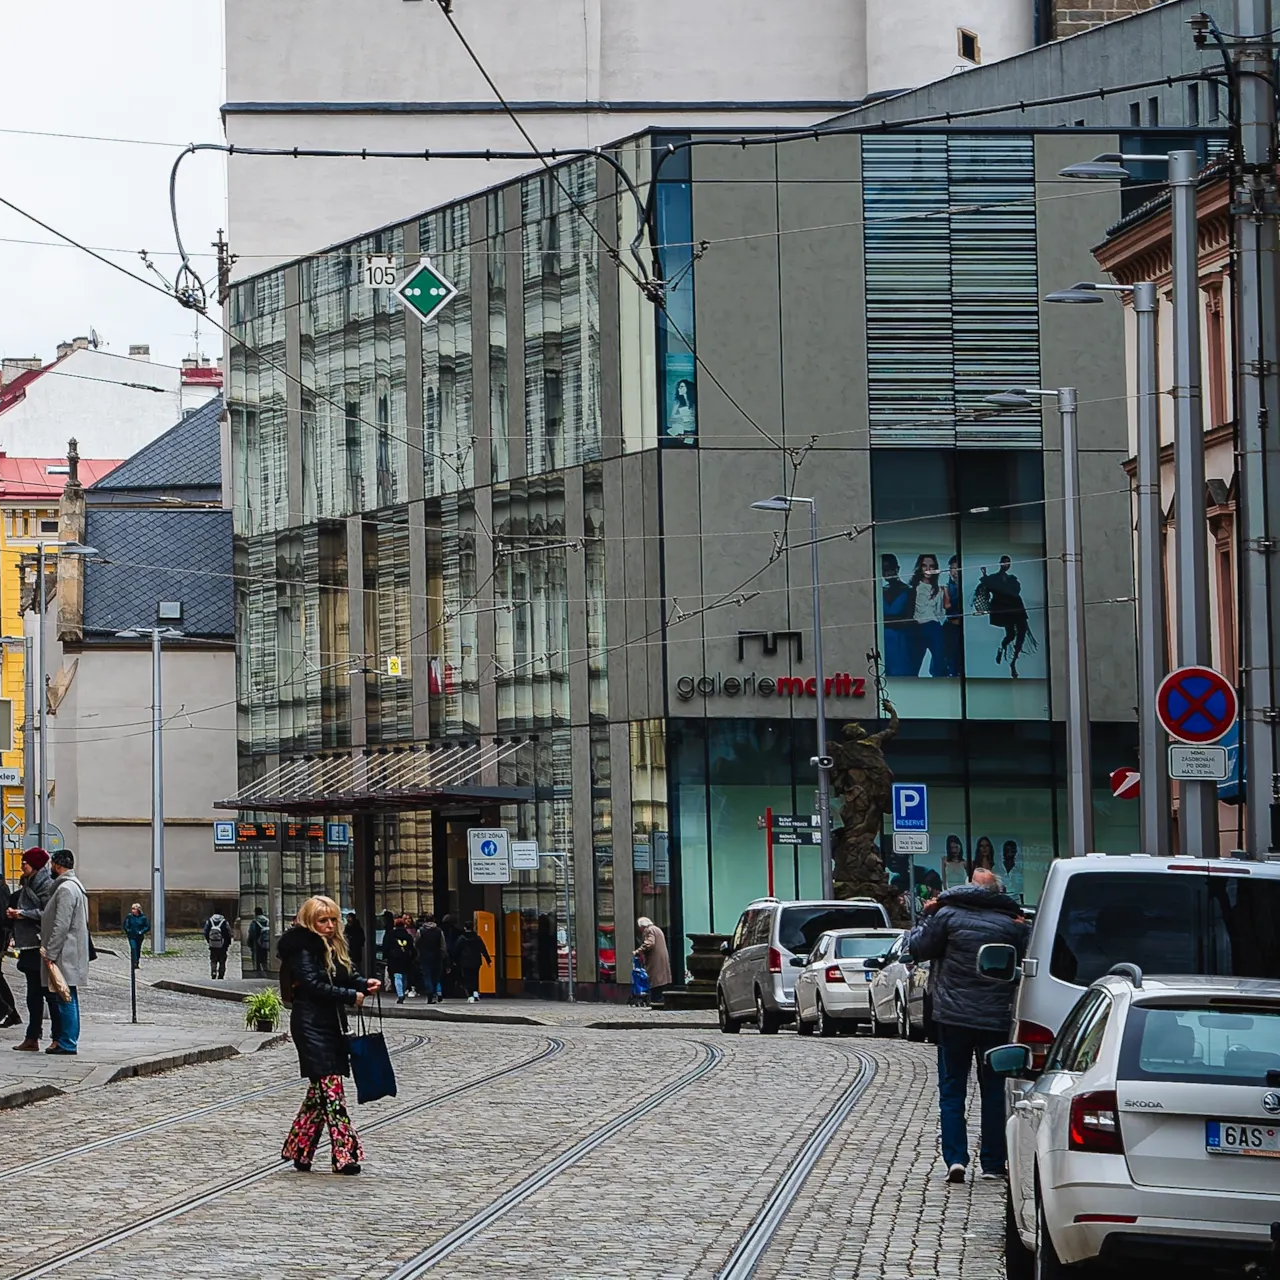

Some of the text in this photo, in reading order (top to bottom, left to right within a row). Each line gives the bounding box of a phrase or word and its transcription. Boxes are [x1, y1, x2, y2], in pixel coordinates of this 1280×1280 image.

[365, 266, 395, 285] 105
[900, 790, 920, 816] P
[1124, 1099, 1164, 1109] ŠKODA
[1226, 1126, 1263, 1147] 6AS
